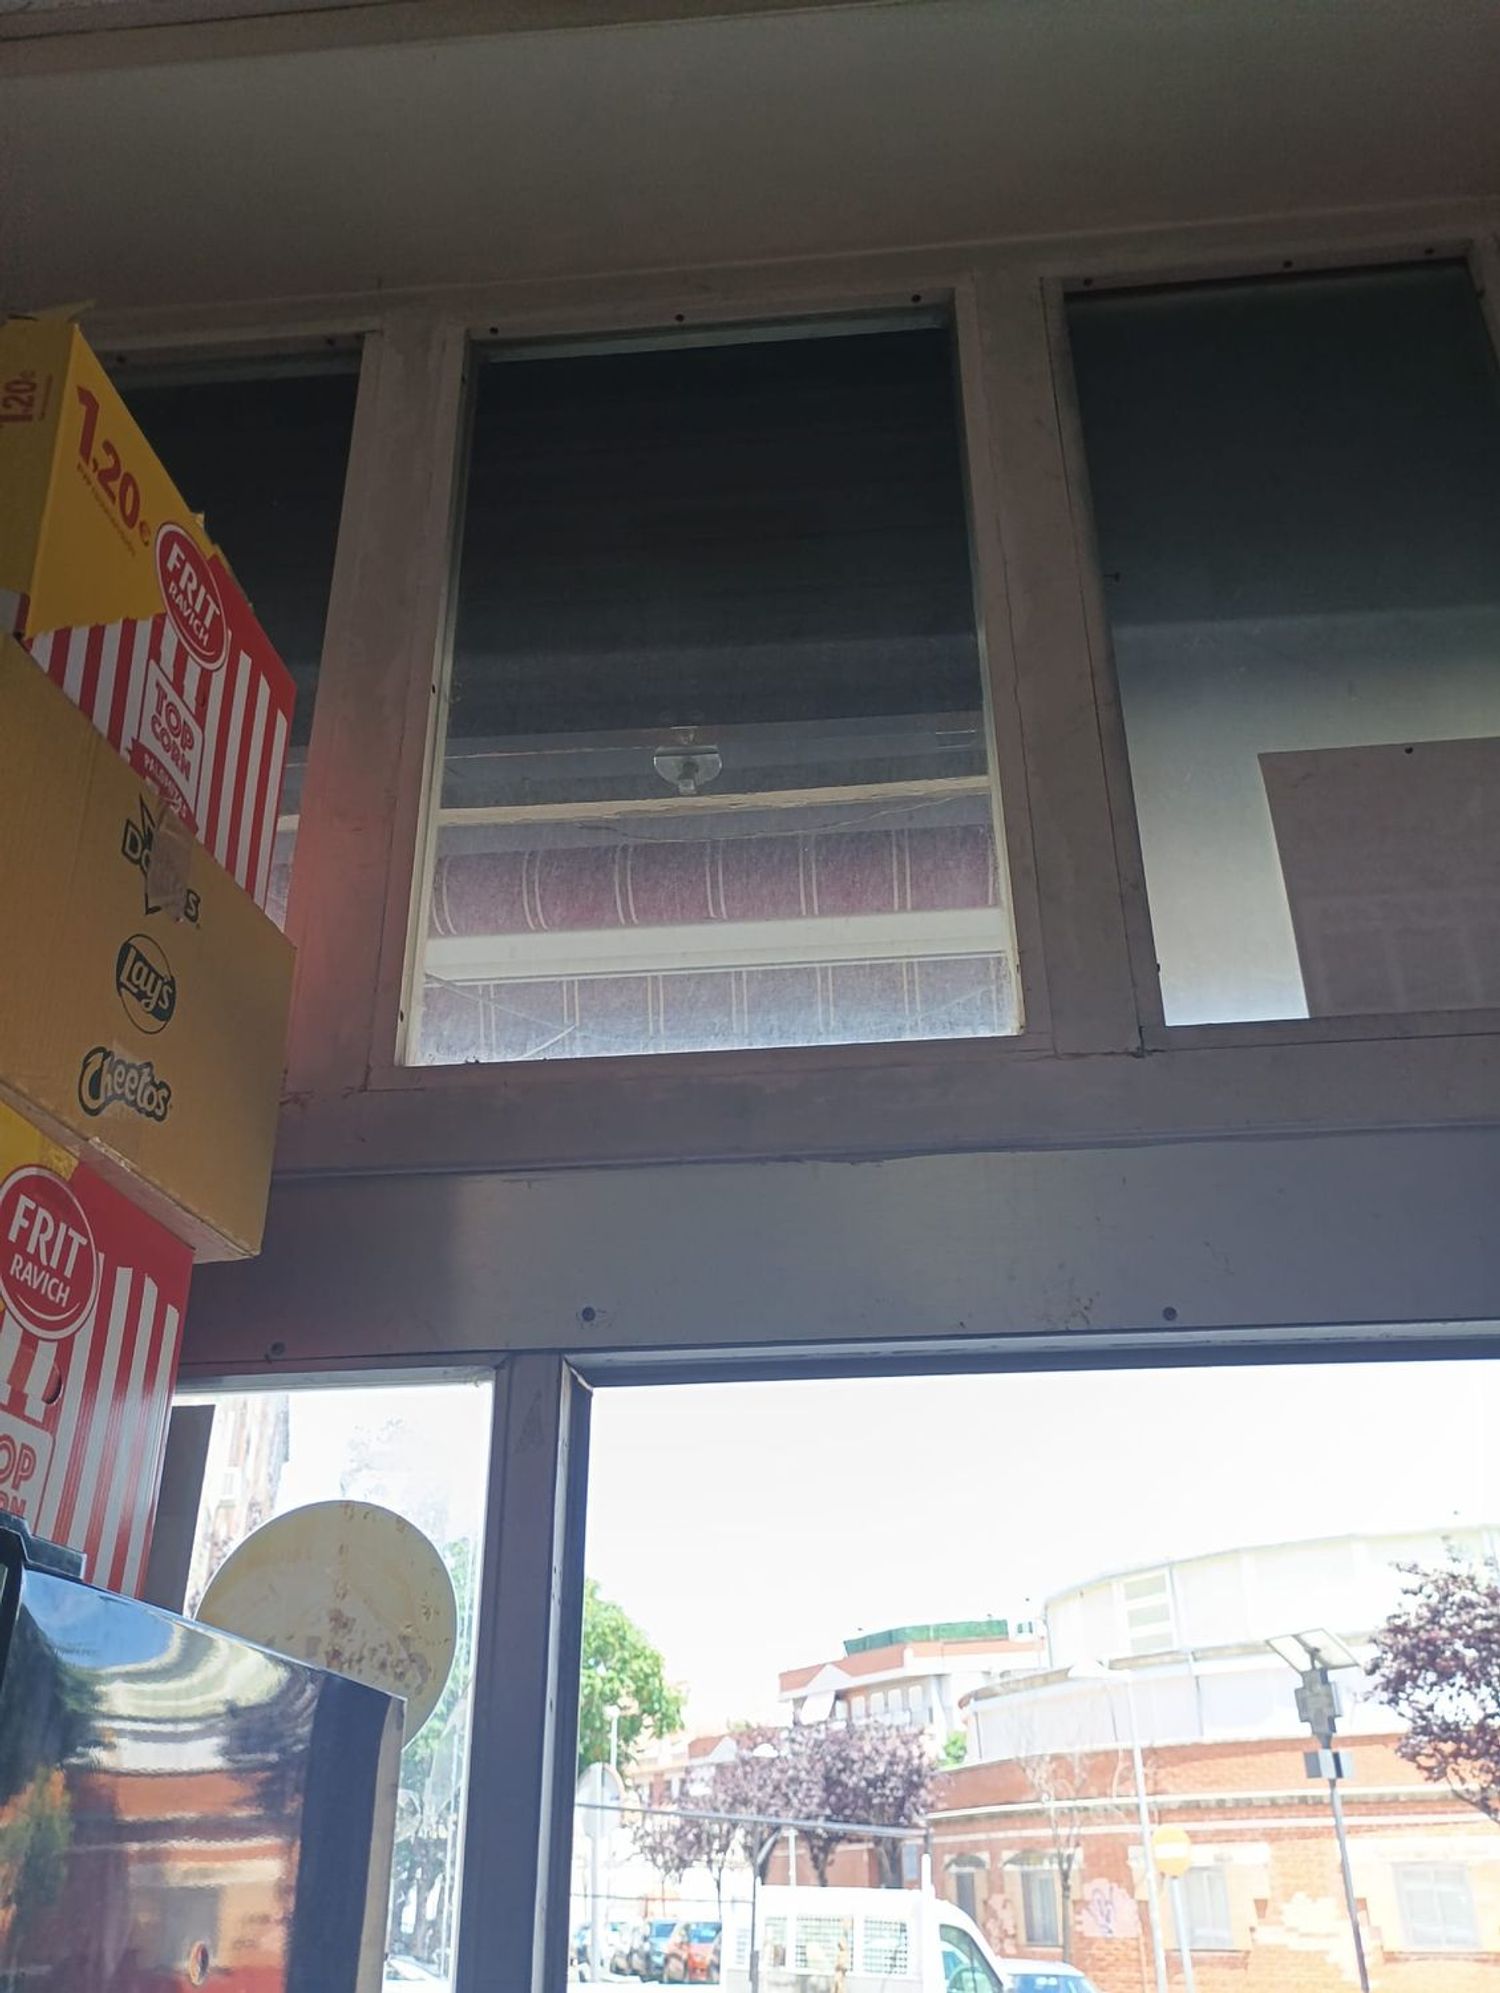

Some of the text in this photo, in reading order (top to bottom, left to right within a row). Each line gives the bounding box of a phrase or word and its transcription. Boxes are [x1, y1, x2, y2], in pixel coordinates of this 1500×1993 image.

[166, 542, 221, 630] FRIT
[168, 582, 209, 647] RAVICH
[150, 714, 192, 782] CORN
[154, 680, 195, 752] TOP
[78, 1046, 172, 1122] Cheetos
[7, 1194, 88, 1279] FRIT
[10, 1253, 71, 1308] RAVICH
[0, 1433, 37, 1490] OP
